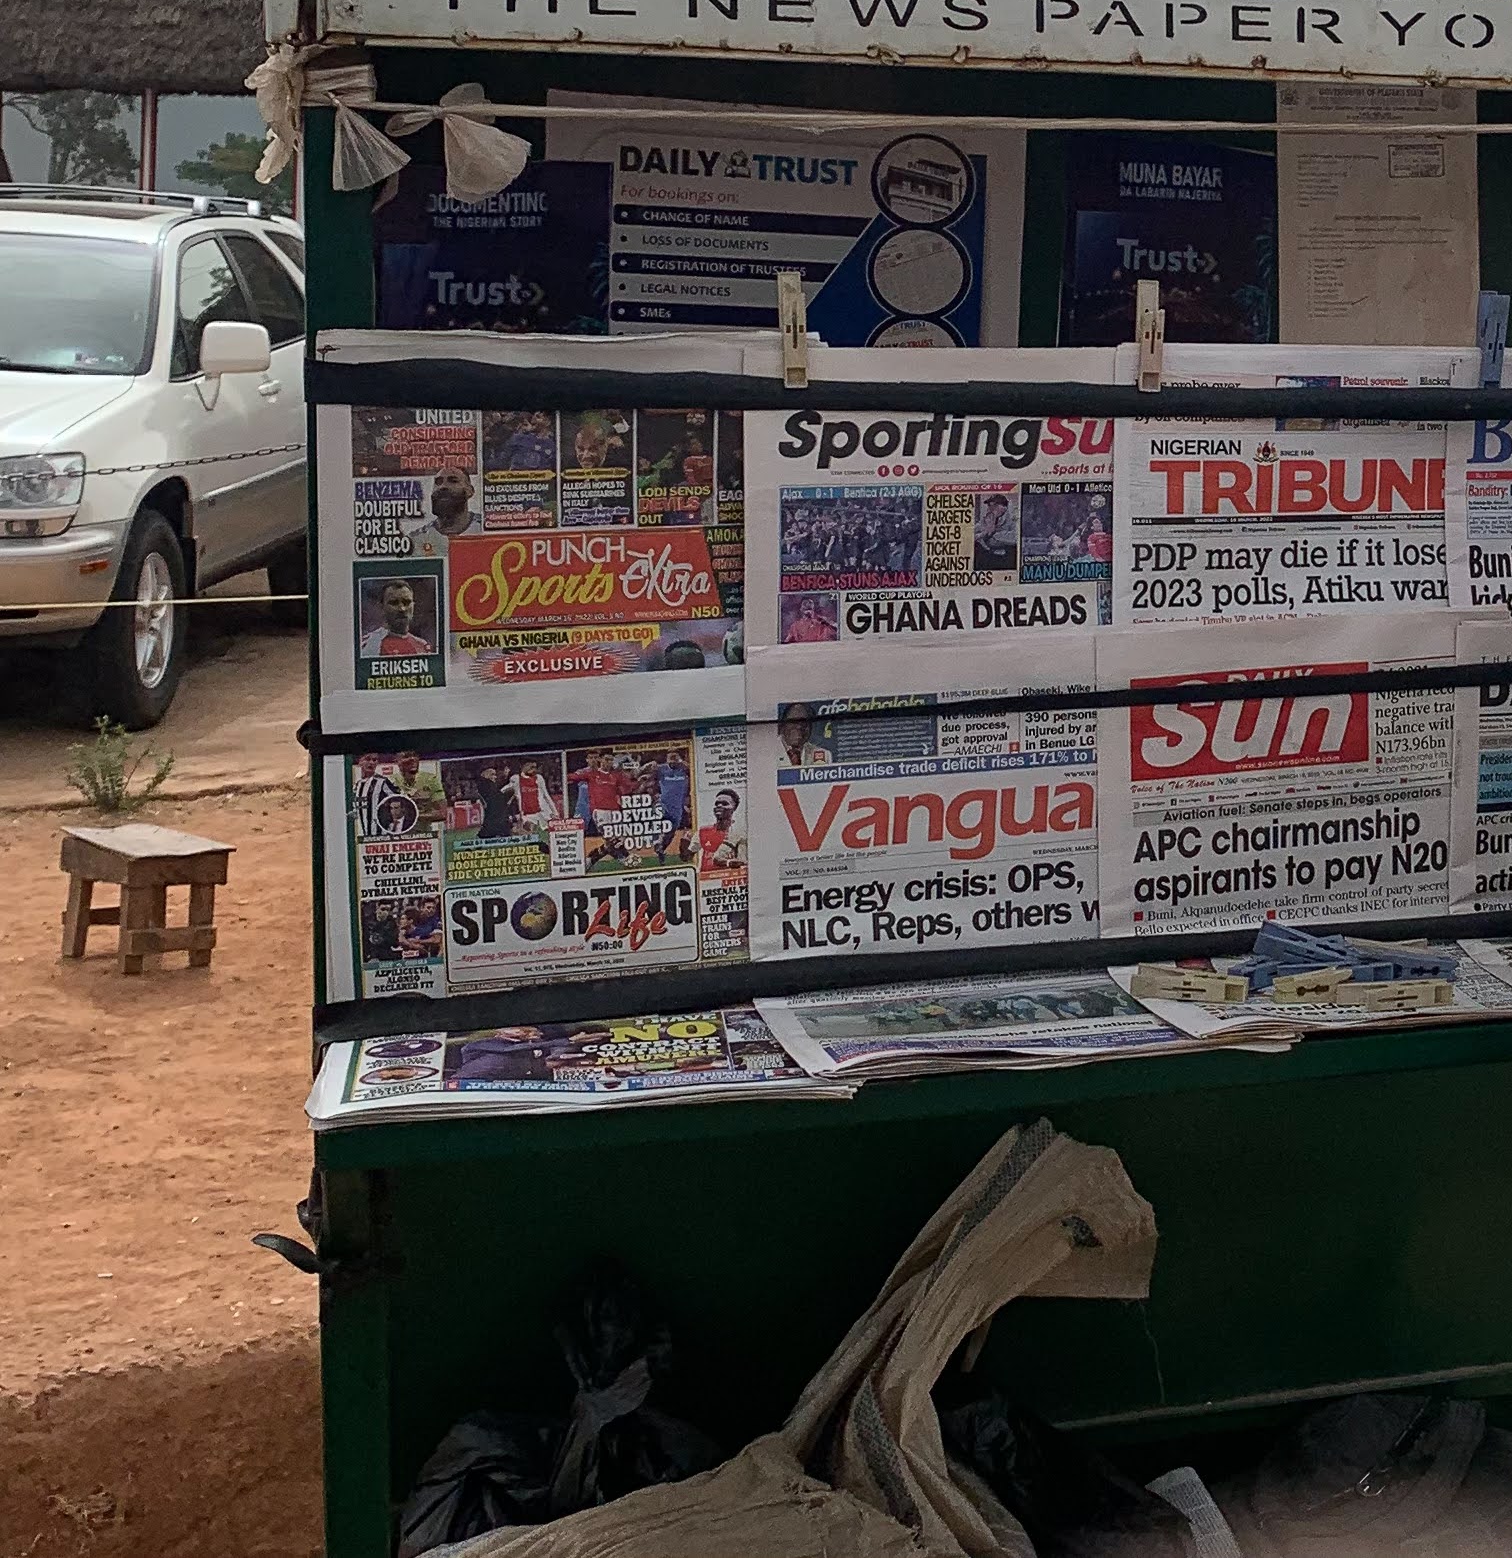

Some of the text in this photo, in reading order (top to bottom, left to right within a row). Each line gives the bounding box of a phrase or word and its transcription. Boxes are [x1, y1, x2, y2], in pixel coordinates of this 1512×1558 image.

[619, 145, 859, 186] DAILY TRUST
[1119, 162, 1168, 186] MUNA
[620, 184, 740, 205] For bookings on:
[642, 210, 750, 227] CHANGE OF NAME
[642, 234, 769, 252] LOSS OF DOCUMENTS
[1116, 238, 1198, 274] Trust
[641, 258, 728, 273] REGISTRATION
[730, 263, 747, 274] OF
[428, 270, 525, 306] Trust
[640, 283, 731, 297] LEGAL NOTICES
[640, 307, 671, 319] SMEs
[415, 408, 473, 425] UNITED
[1150, 440, 1242, 456] NIGERIAN
[638, 485, 711, 498] LODI SENDS
[354, 499, 423, 518] DOUBTFUL
[926, 493, 976, 509] CHELSEA
[638, 513, 664, 525] OUT
[926, 509, 972, 524] TARGETS
[354, 518, 401, 536] FOR EL
[926, 526, 961, 540] LAST-8
[354, 536, 411, 555] CLASICO
[532, 533, 626, 566] PUNCH
[926, 541, 962, 556] TICKET
[925, 556, 971, 571] AGAINST
[1131, 538, 1447, 576] PDP may die if it lose
[455, 541, 616, 626] Sports
[781, 570, 918, 591] BENFICA STUNS AJAX
[925, 571, 993, 587] UNDERDOGS
[1131, 577, 1203, 609] 2023
[1211, 576, 1295, 613] polls,
[1302, 575, 1385, 604] Atiku
[691, 605, 720, 619] N50
[846, 594, 1087, 634] GHANA DREADS
[458, 632, 500, 650] GHANA
[502, 632, 519, 647] VS
[520, 630, 570, 646] NIGERIA
[584, 630, 613, 642] DAYS
[615, 629, 632, 641] TO
[633, 628, 654, 641] GO)
[371, 659, 430, 676] ERIKSEN
[504, 656, 604, 675] EXCLUSIVE
[1024, 710, 1097, 723] 390 persons
[941, 722, 1011, 733] due process,
[941, 731, 1008, 746] got approval
[1375, 735, 1446, 754] N173.96bn
[800, 749, 1088, 782] Merchandise trade deficit rises 171% to
[620, 793, 652, 809] RED
[1163, 808, 1216, 823] Aviation
[1218, 805, 1246, 819] fuel:
[1249, 800, 1293, 815] Senate
[1296, 797, 1330, 810] steps
[1332, 794, 1347, 807] in,
[1350, 791, 1381, 806] begs
[1383, 787, 1442, 802] operators
[612, 806, 664, 824] DEVILS
[777, 781, 1096, 861] Vangua
[1476, 815, 1499, 827] APC
[602, 819, 673, 839] BUNDLED
[1132, 806, 1421, 863] APC chairmanship
[624, 835, 654, 851] OUT
[365, 860, 433, 875] TO COMPETE
[1133, 840, 1448, 906] aspirants to pay N20
[781, 860, 1084, 915] Energy crisis: OPS,
[1147, 909, 1177, 922] Buni,
[1274, 896, 1298, 908] take
[1302, 893, 1325, 904] firm
[1328, 888, 1368, 902] control
[1371, 886, 1383, 896] of
[1385, 884, 1414, 895] party
[584, 899, 668, 951] Life
[782, 915, 861, 950] NLC,
[872, 911, 962, 945] Reps,
[972, 898, 1073, 932] others
[609, 1020, 718, 1043] NO
[581, 1036, 721, 1053] CONTRACT
